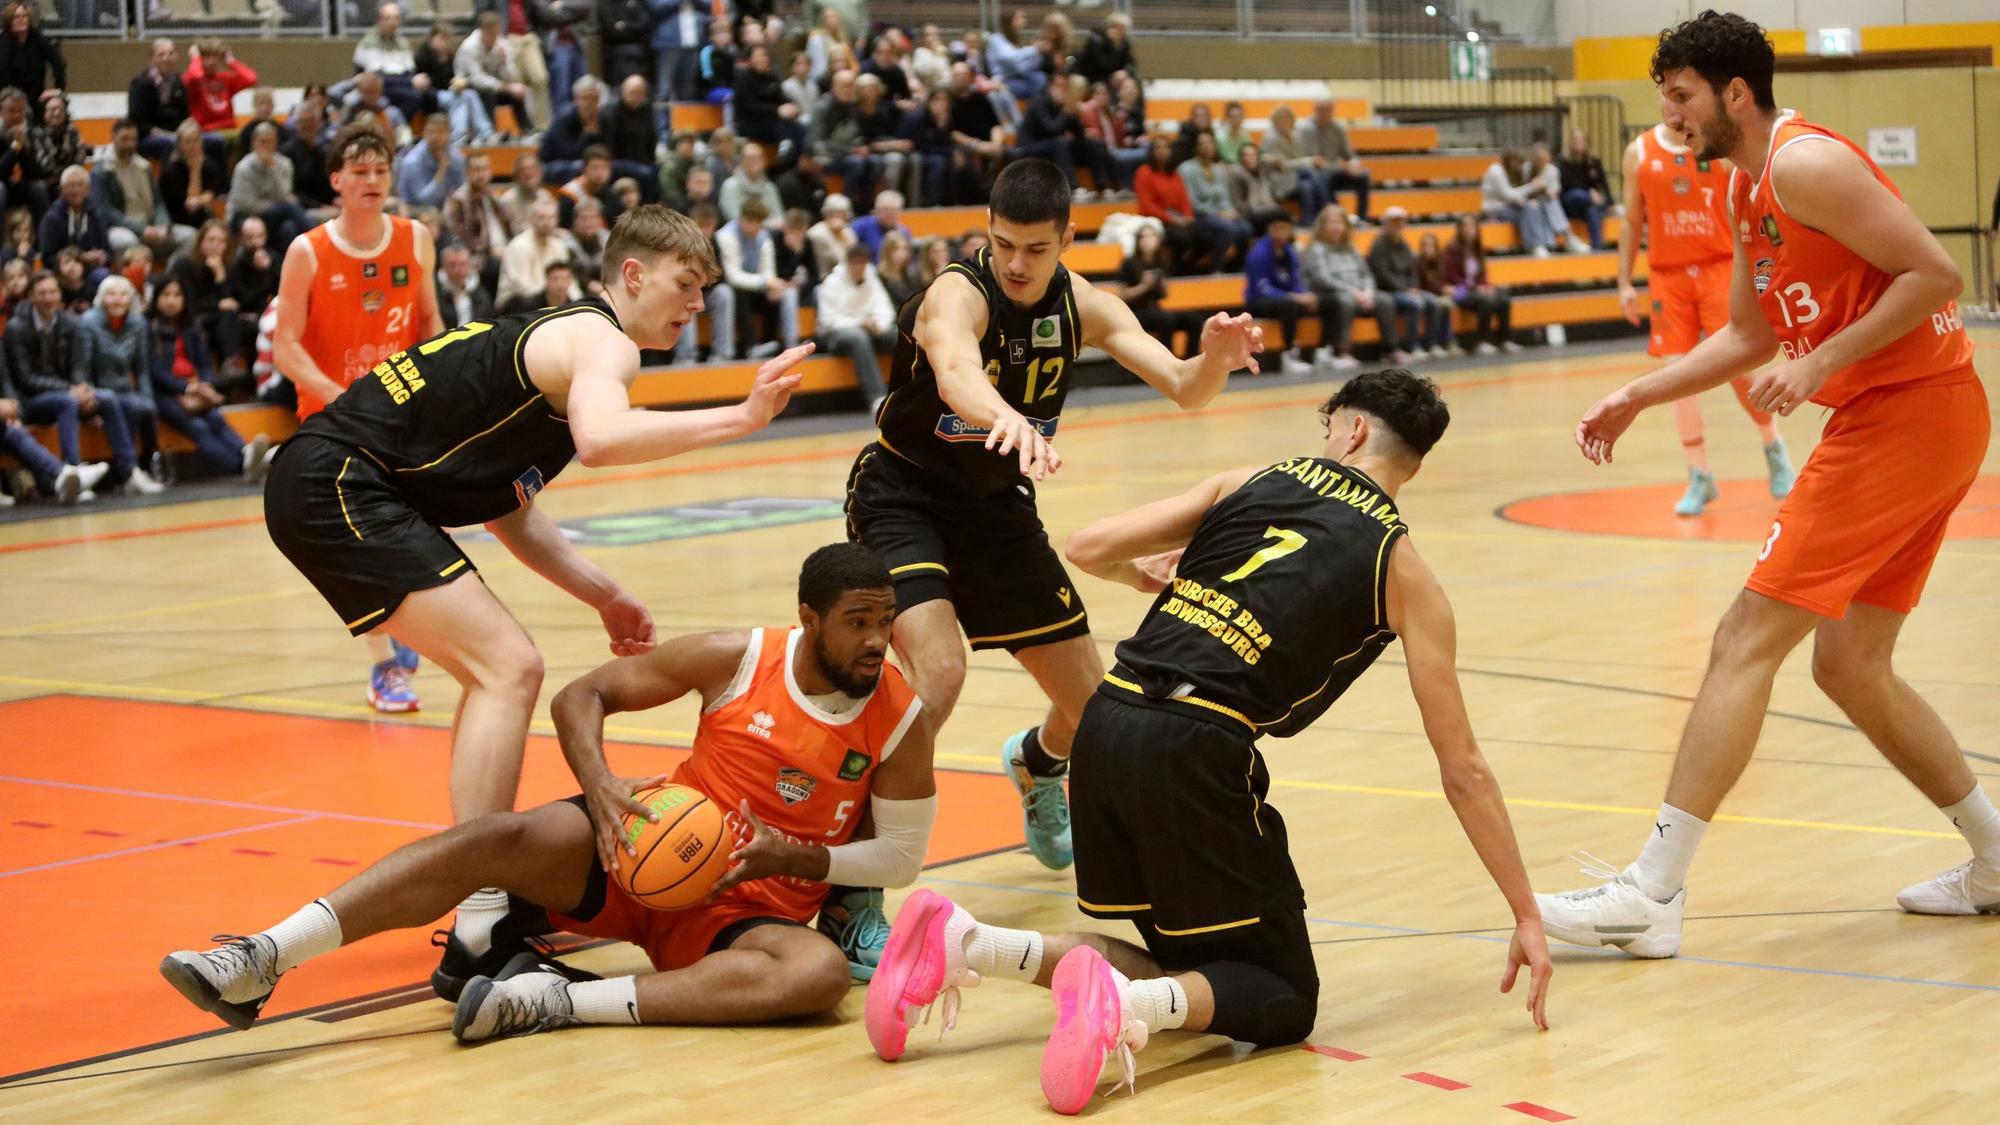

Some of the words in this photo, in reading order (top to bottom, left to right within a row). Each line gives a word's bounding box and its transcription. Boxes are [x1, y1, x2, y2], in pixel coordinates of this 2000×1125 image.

[1701, 187, 1713, 208] 7
[1774, 281, 1820, 328] 13
[396, 357, 426, 393] BBA
[1023, 356, 1064, 404] 12
[1276, 458, 1379, 514] SANTANA
[1221, 525, 1308, 583] 7
[1233, 608, 1273, 651] BBA
[825, 801, 855, 837] 5
[678, 837, 704, 864] FIBA
